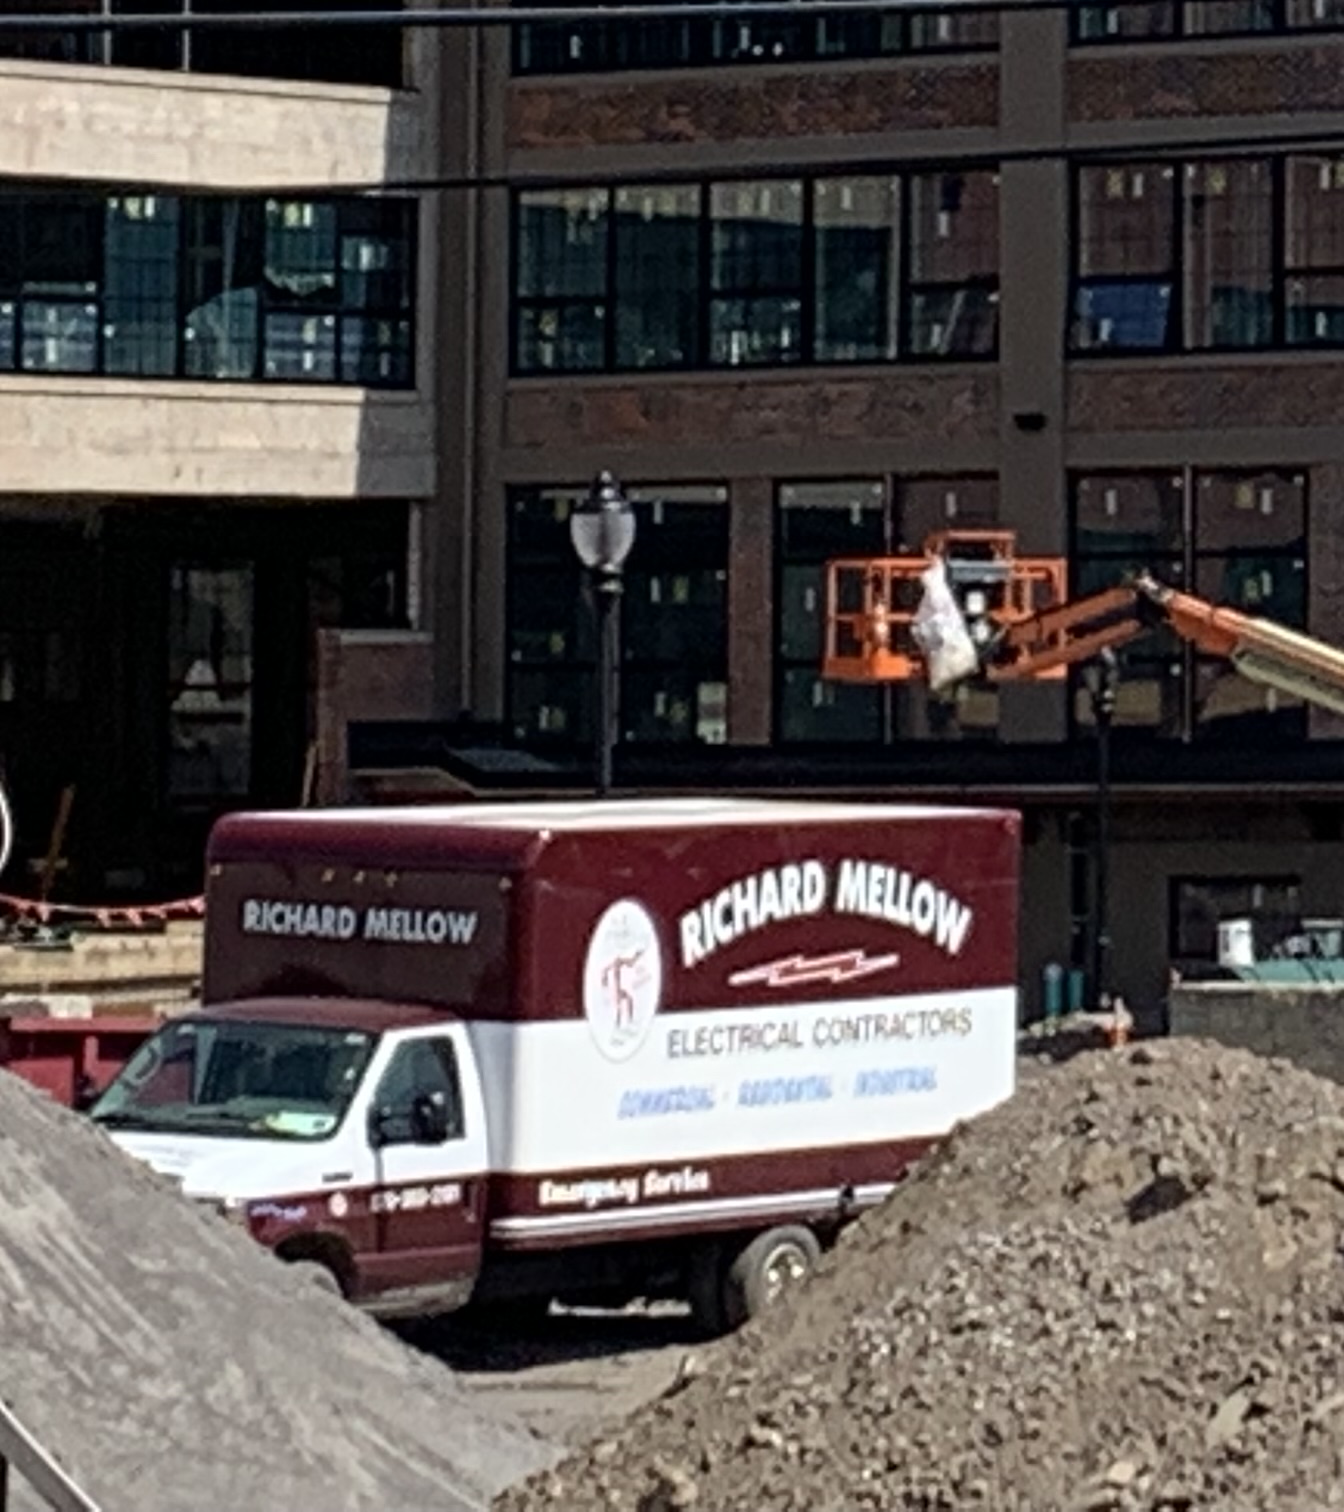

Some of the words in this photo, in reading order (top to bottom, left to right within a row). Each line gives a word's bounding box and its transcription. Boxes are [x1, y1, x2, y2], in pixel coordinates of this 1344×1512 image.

[242, 899, 356, 939] RICHARD
[363, 907, 478, 944] MELLOW
[678, 859, 827, 967] RICHARD
[836, 859, 972, 954] MELLOW
[667, 1023, 804, 1059] ELECTRICAL
[812, 1007, 973, 1048] CONTRACTORS
